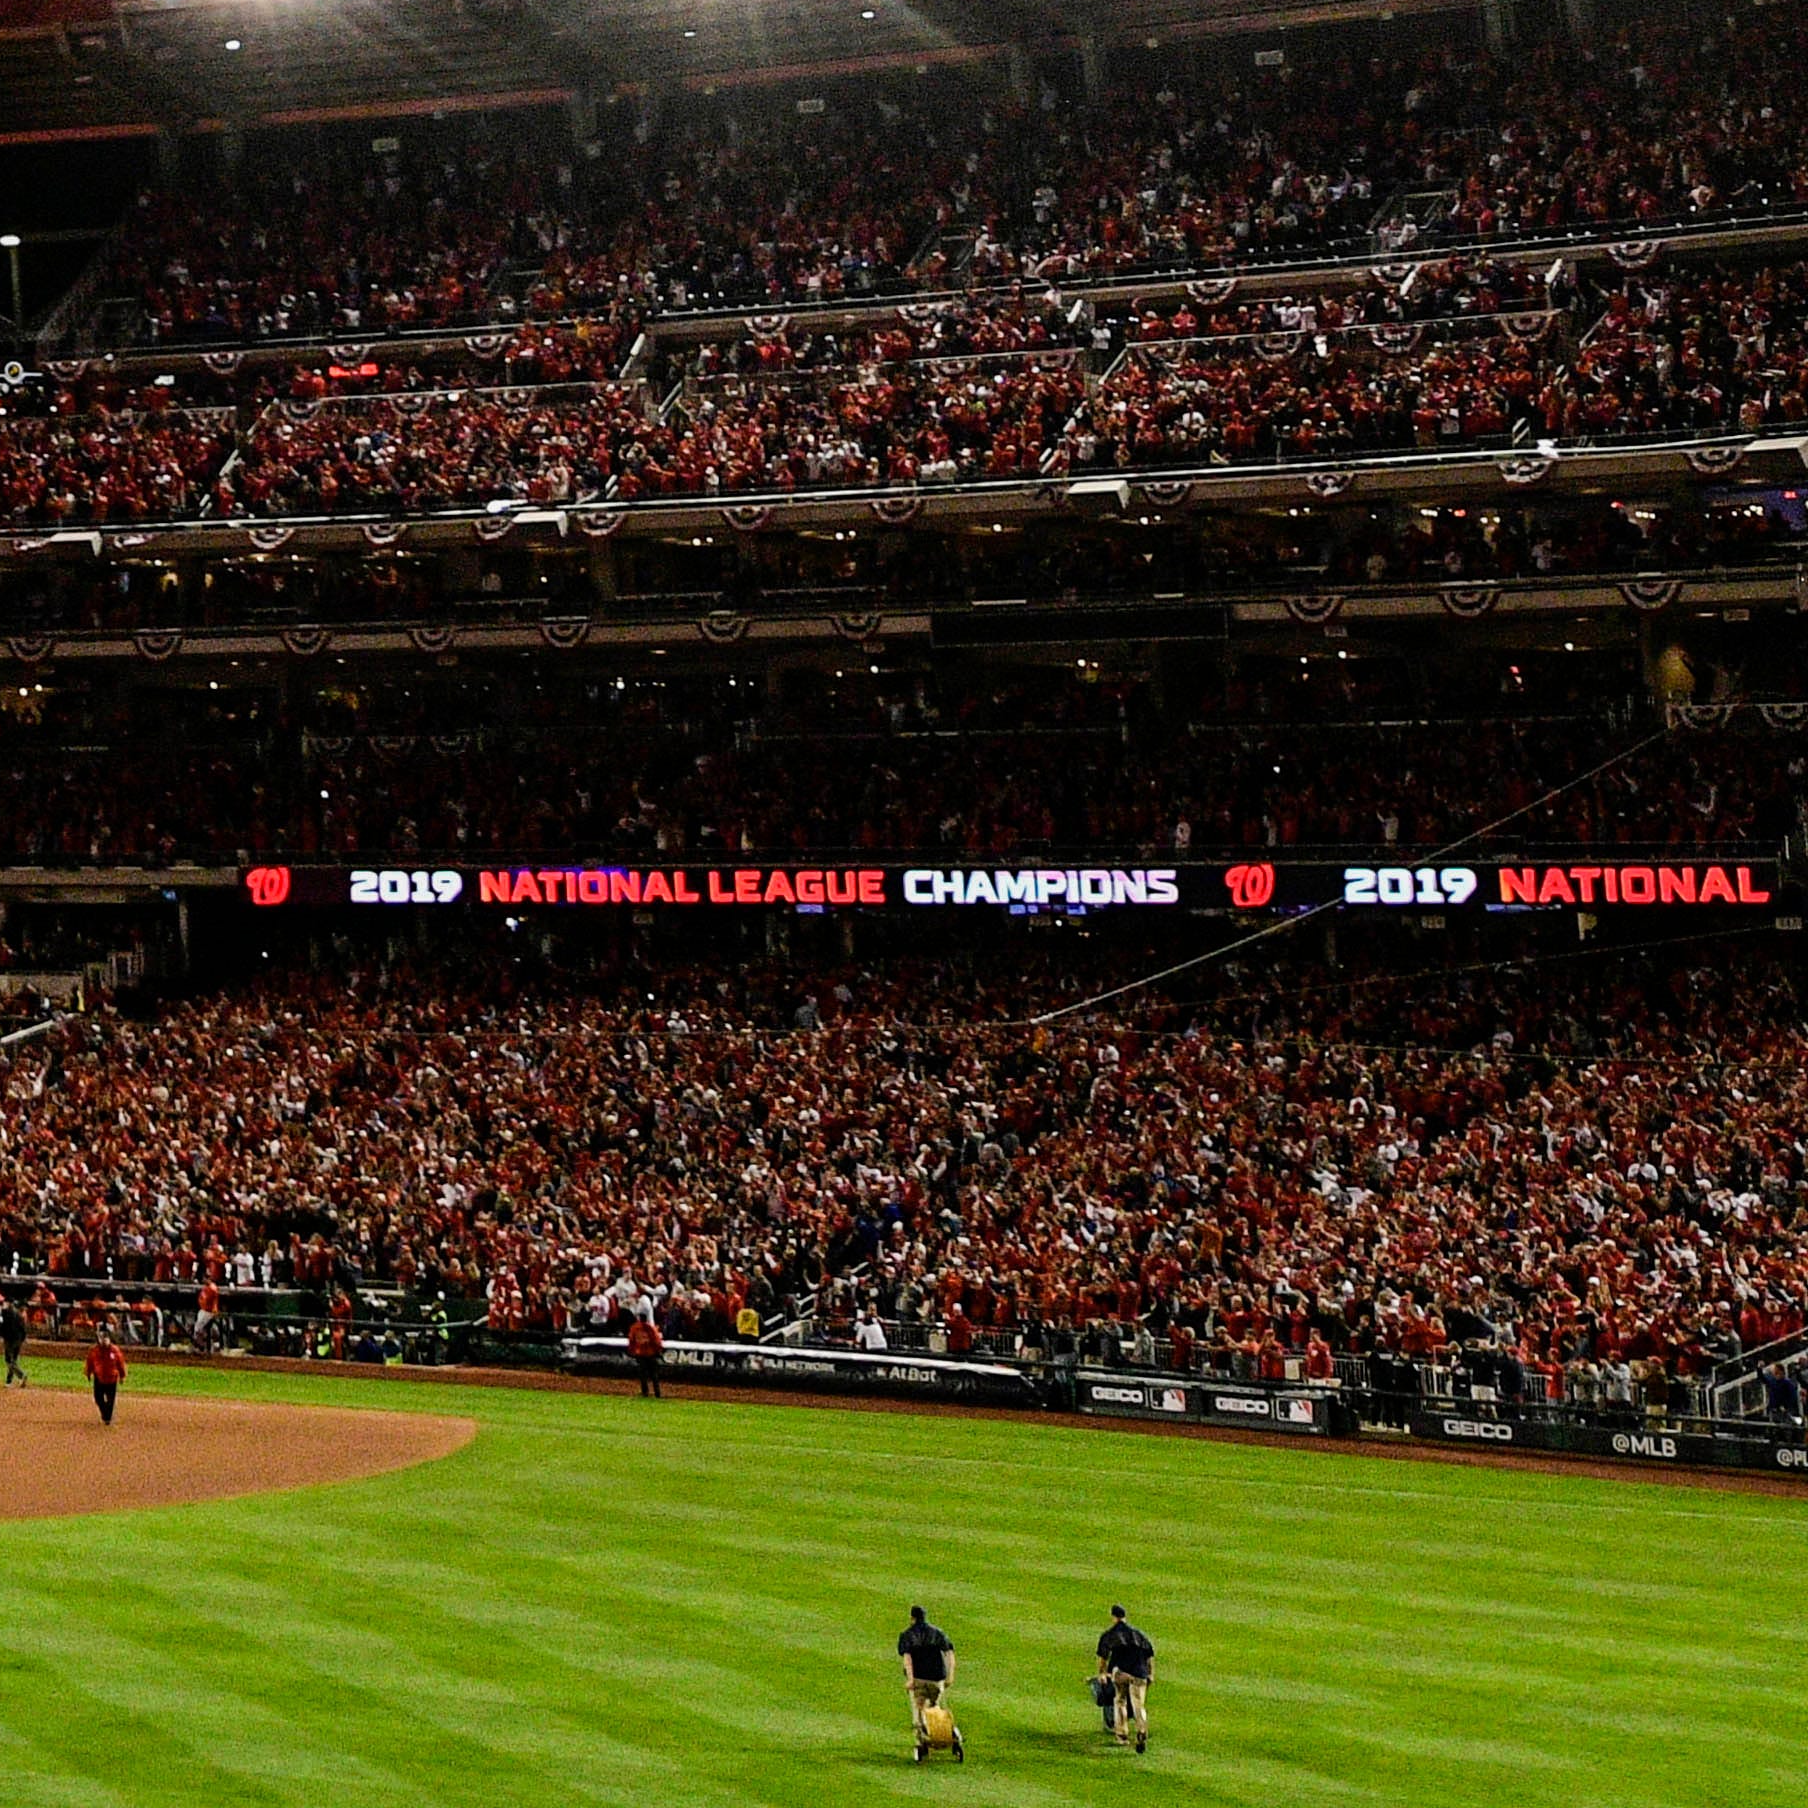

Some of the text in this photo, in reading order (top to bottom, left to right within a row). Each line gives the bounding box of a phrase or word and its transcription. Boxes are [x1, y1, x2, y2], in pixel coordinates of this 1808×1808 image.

[350, 869, 1179, 904] 2019 NATIONAL LEAGUE CHAMPIONS
[1344, 866, 1770, 904] 2019 NATIONAL
[661, 1348, 714, 1366] @MLB
[1091, 1386, 1143, 1404] GEICO
[1215, 1396, 1269, 1415] GEICO
[1443, 1418, 1513, 1441] GEICO
[1612, 1433, 1676, 1458] @MLB
